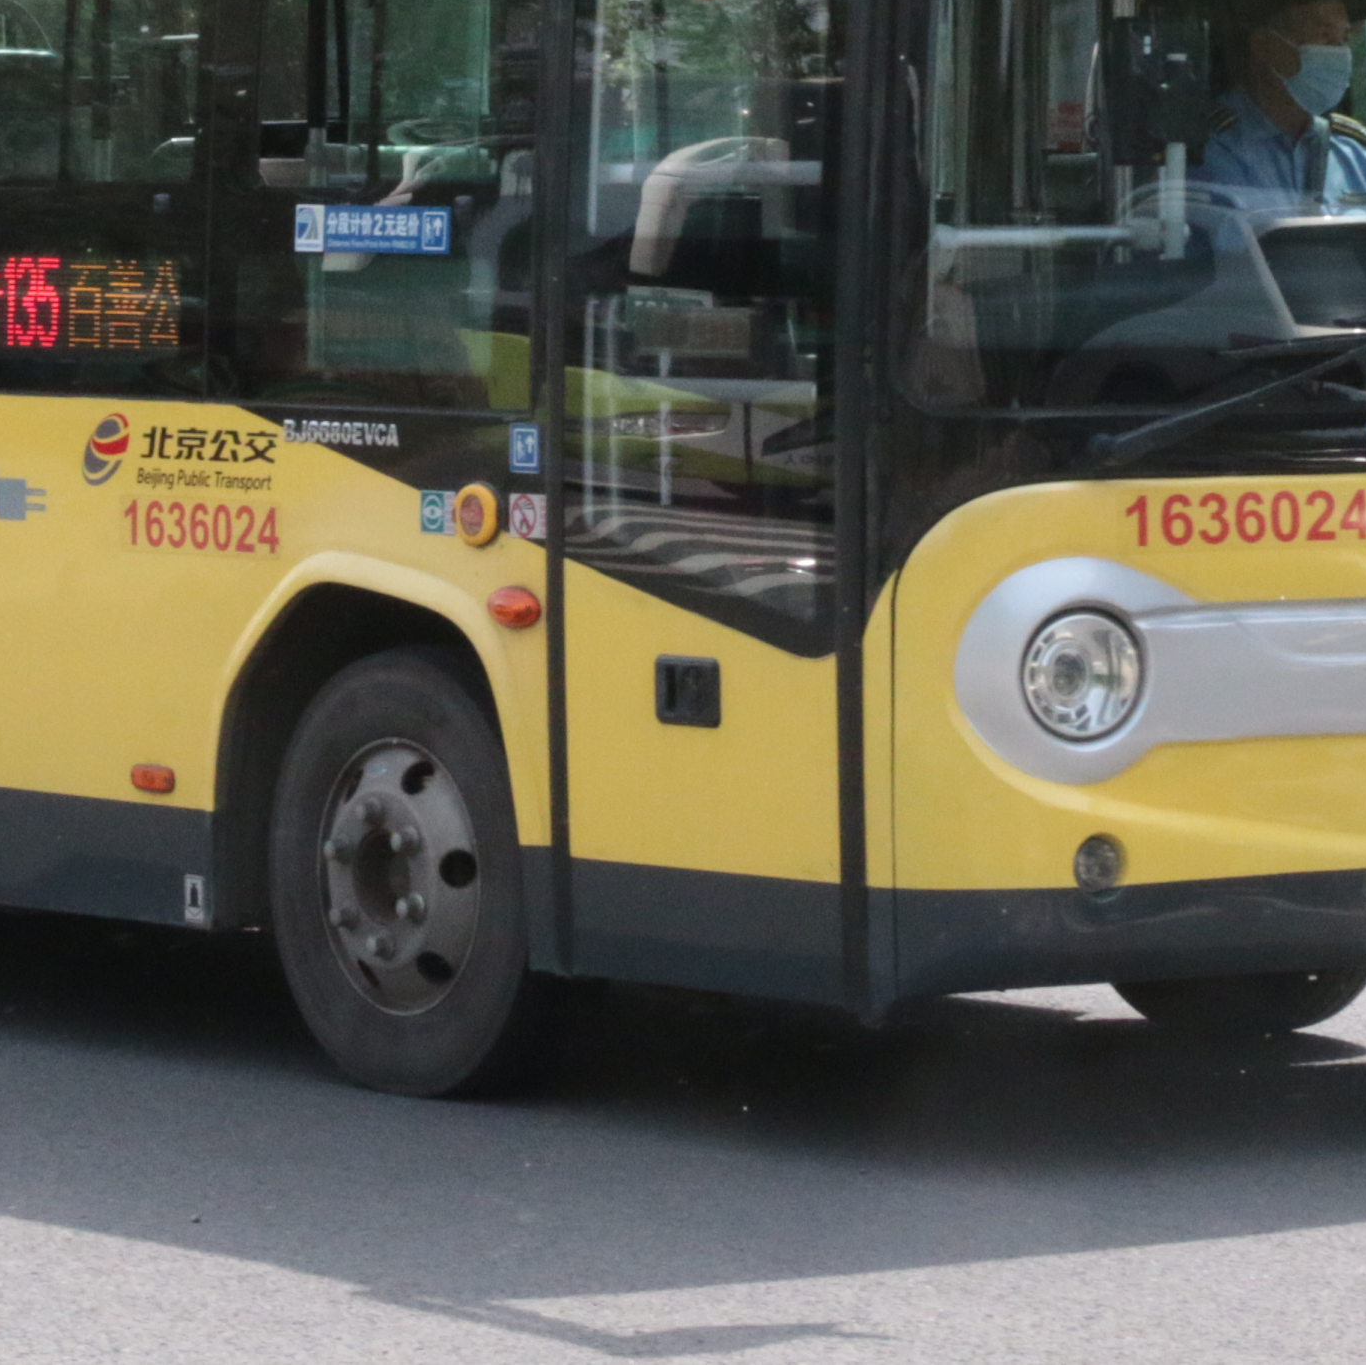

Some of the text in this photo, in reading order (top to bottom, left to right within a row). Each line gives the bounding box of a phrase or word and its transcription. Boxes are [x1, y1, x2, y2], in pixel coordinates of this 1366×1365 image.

[139, 426, 279, 464] 北京公交
[136, 467, 272, 493] Beijing Public Transport
[123, 498, 280, 555] 1636024
